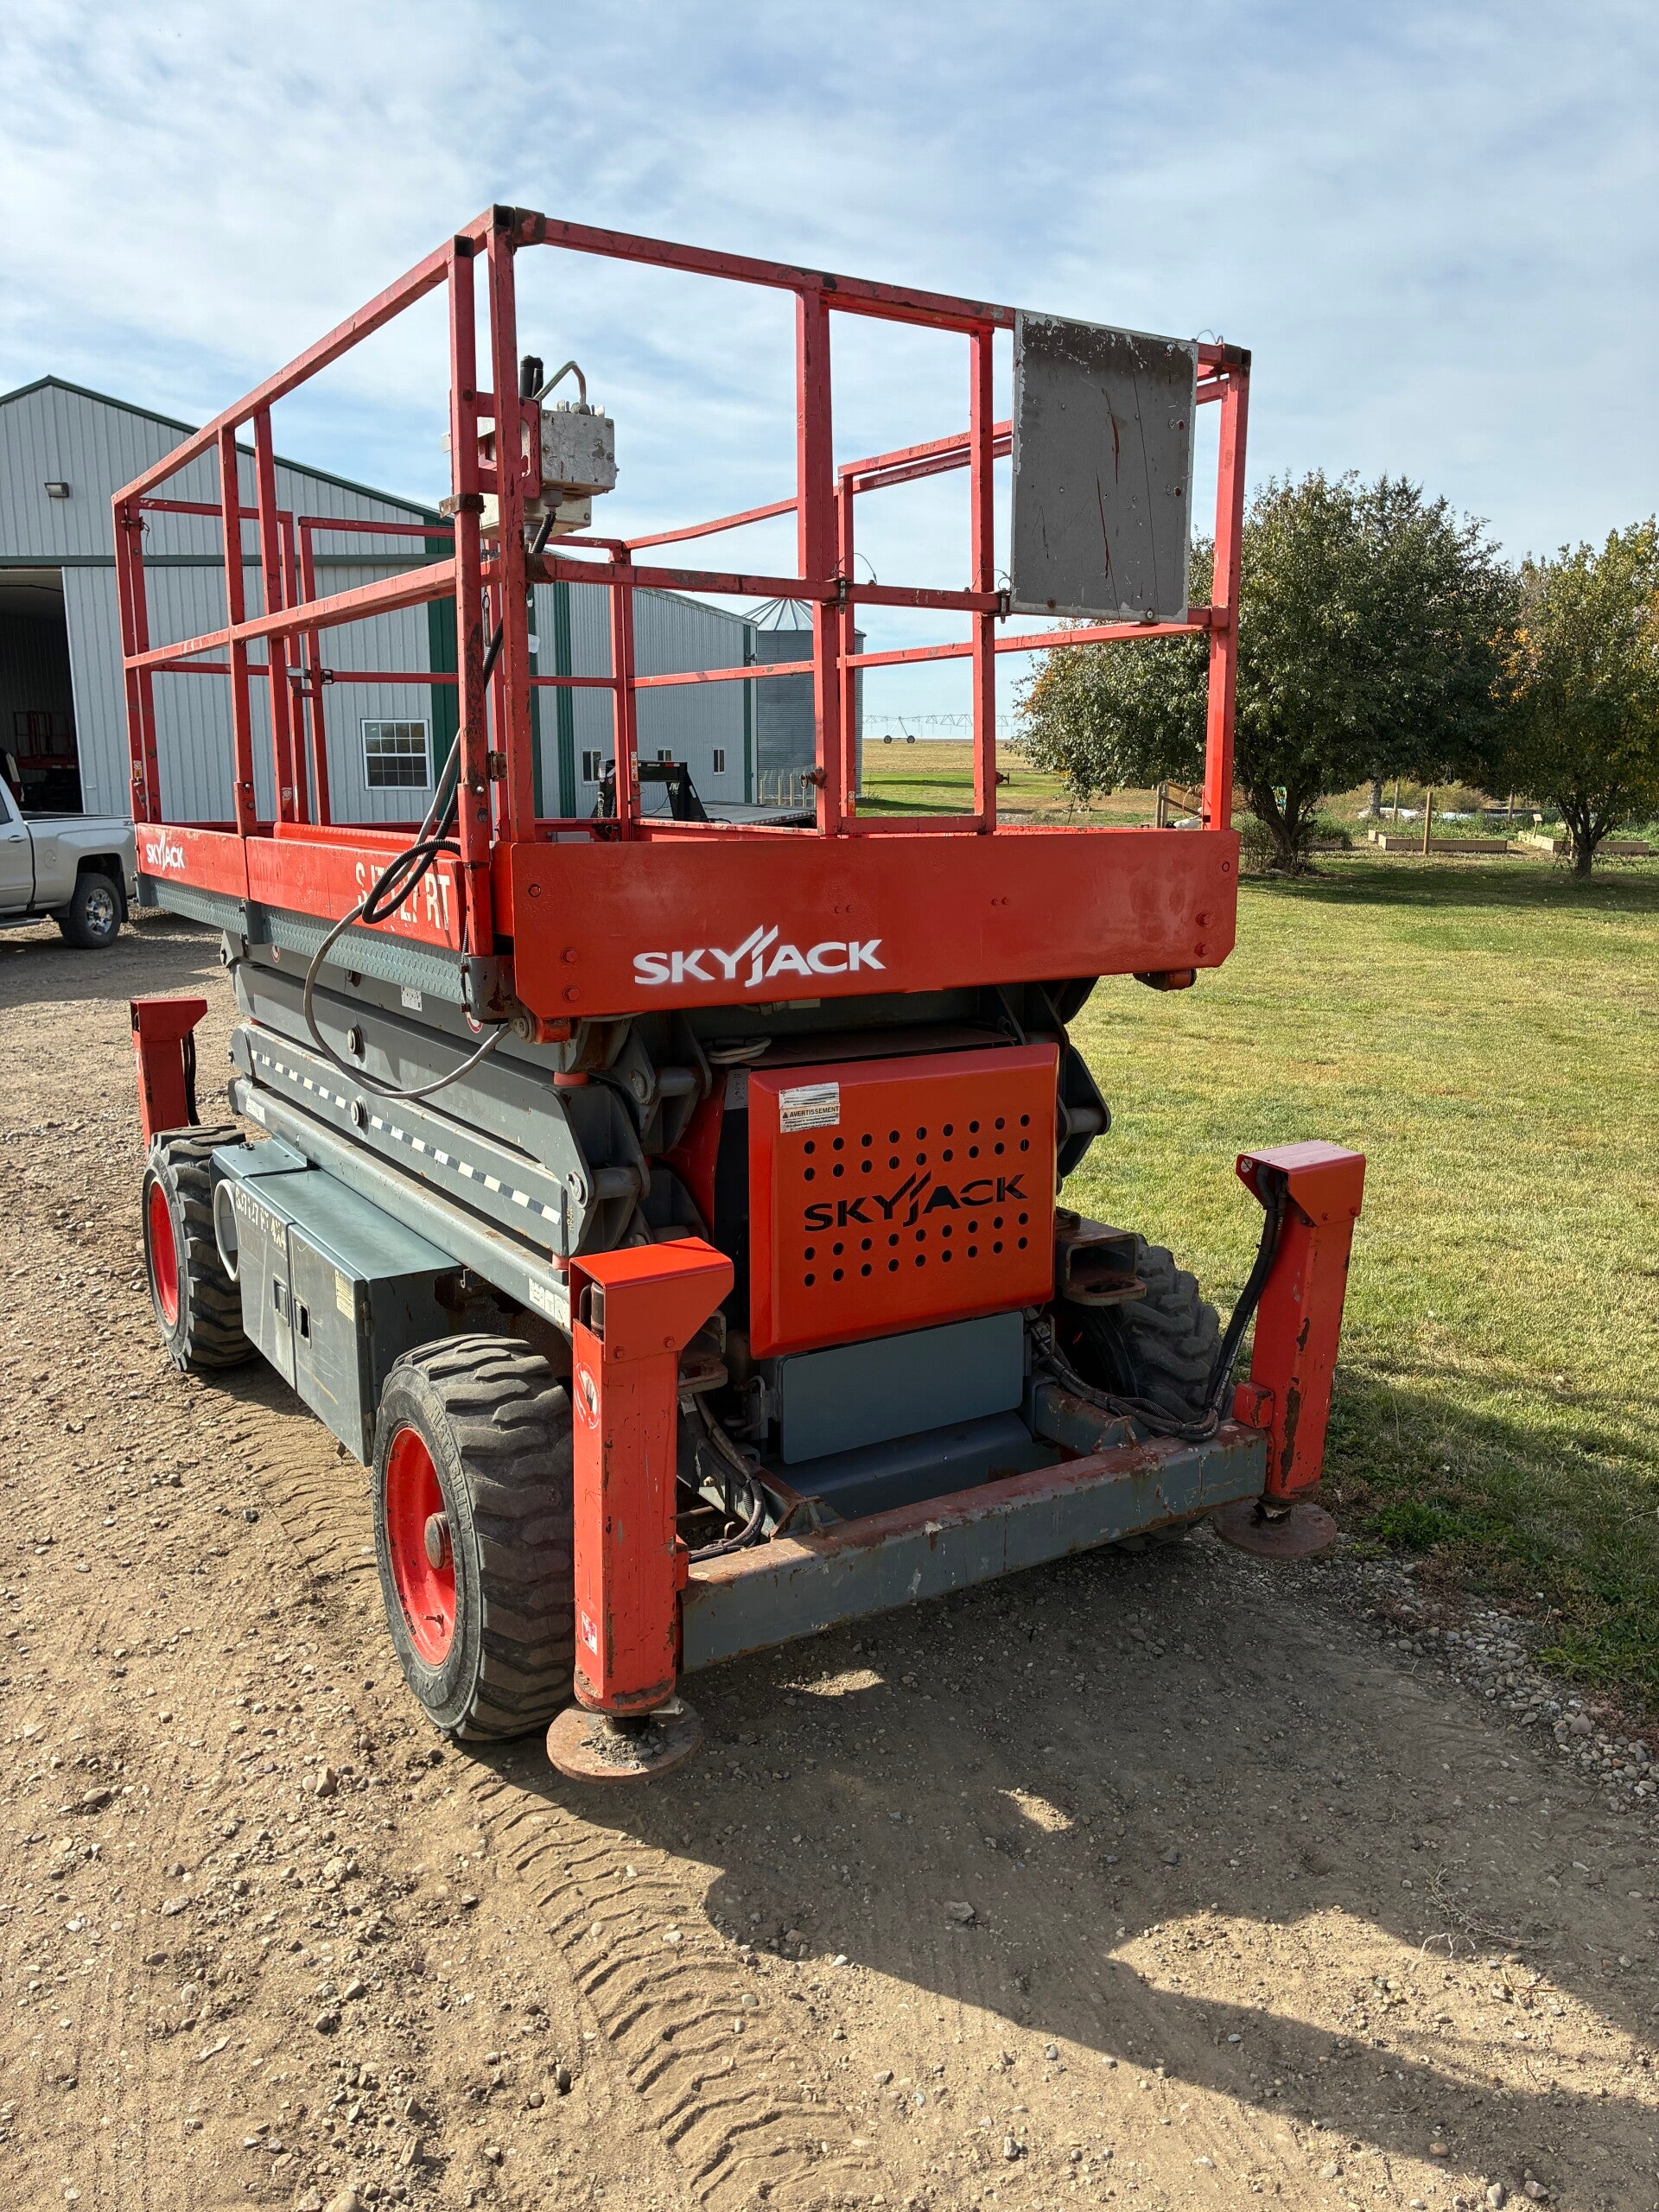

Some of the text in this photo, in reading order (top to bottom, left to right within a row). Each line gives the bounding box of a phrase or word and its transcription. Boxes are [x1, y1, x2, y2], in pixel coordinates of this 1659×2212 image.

[146, 832, 186, 871] SKYJACK
[424, 872, 450, 931] RT
[632, 925, 887, 988] SKYJACK
[790, 1106, 839, 1117] AVERTISSEMENT
[804, 1170, 1029, 1231] SKYJACK
